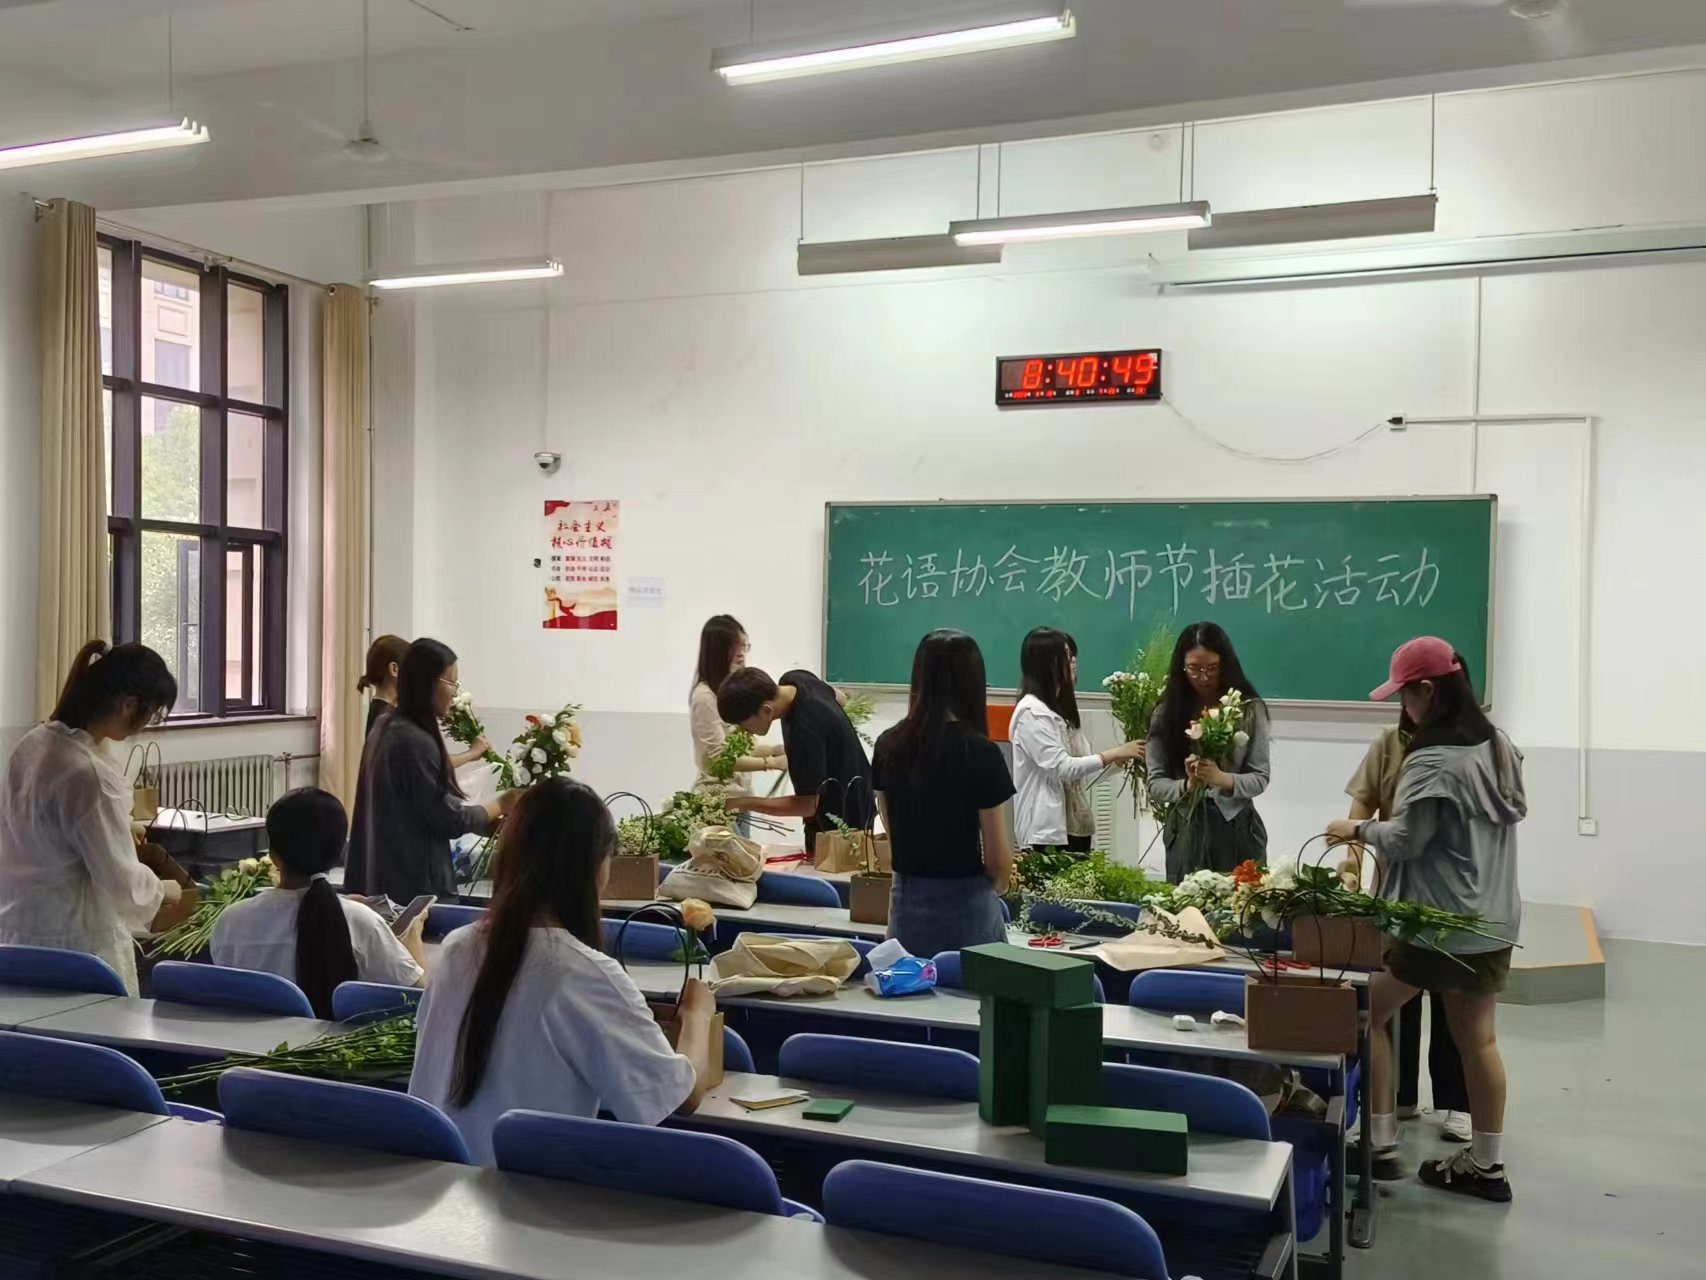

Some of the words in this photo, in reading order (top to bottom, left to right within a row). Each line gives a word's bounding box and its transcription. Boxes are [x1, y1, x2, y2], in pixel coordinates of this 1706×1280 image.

[558, 520, 606, 532] 社会主义
[857, 542, 1441, 622] 花语协会教师节插花活动
